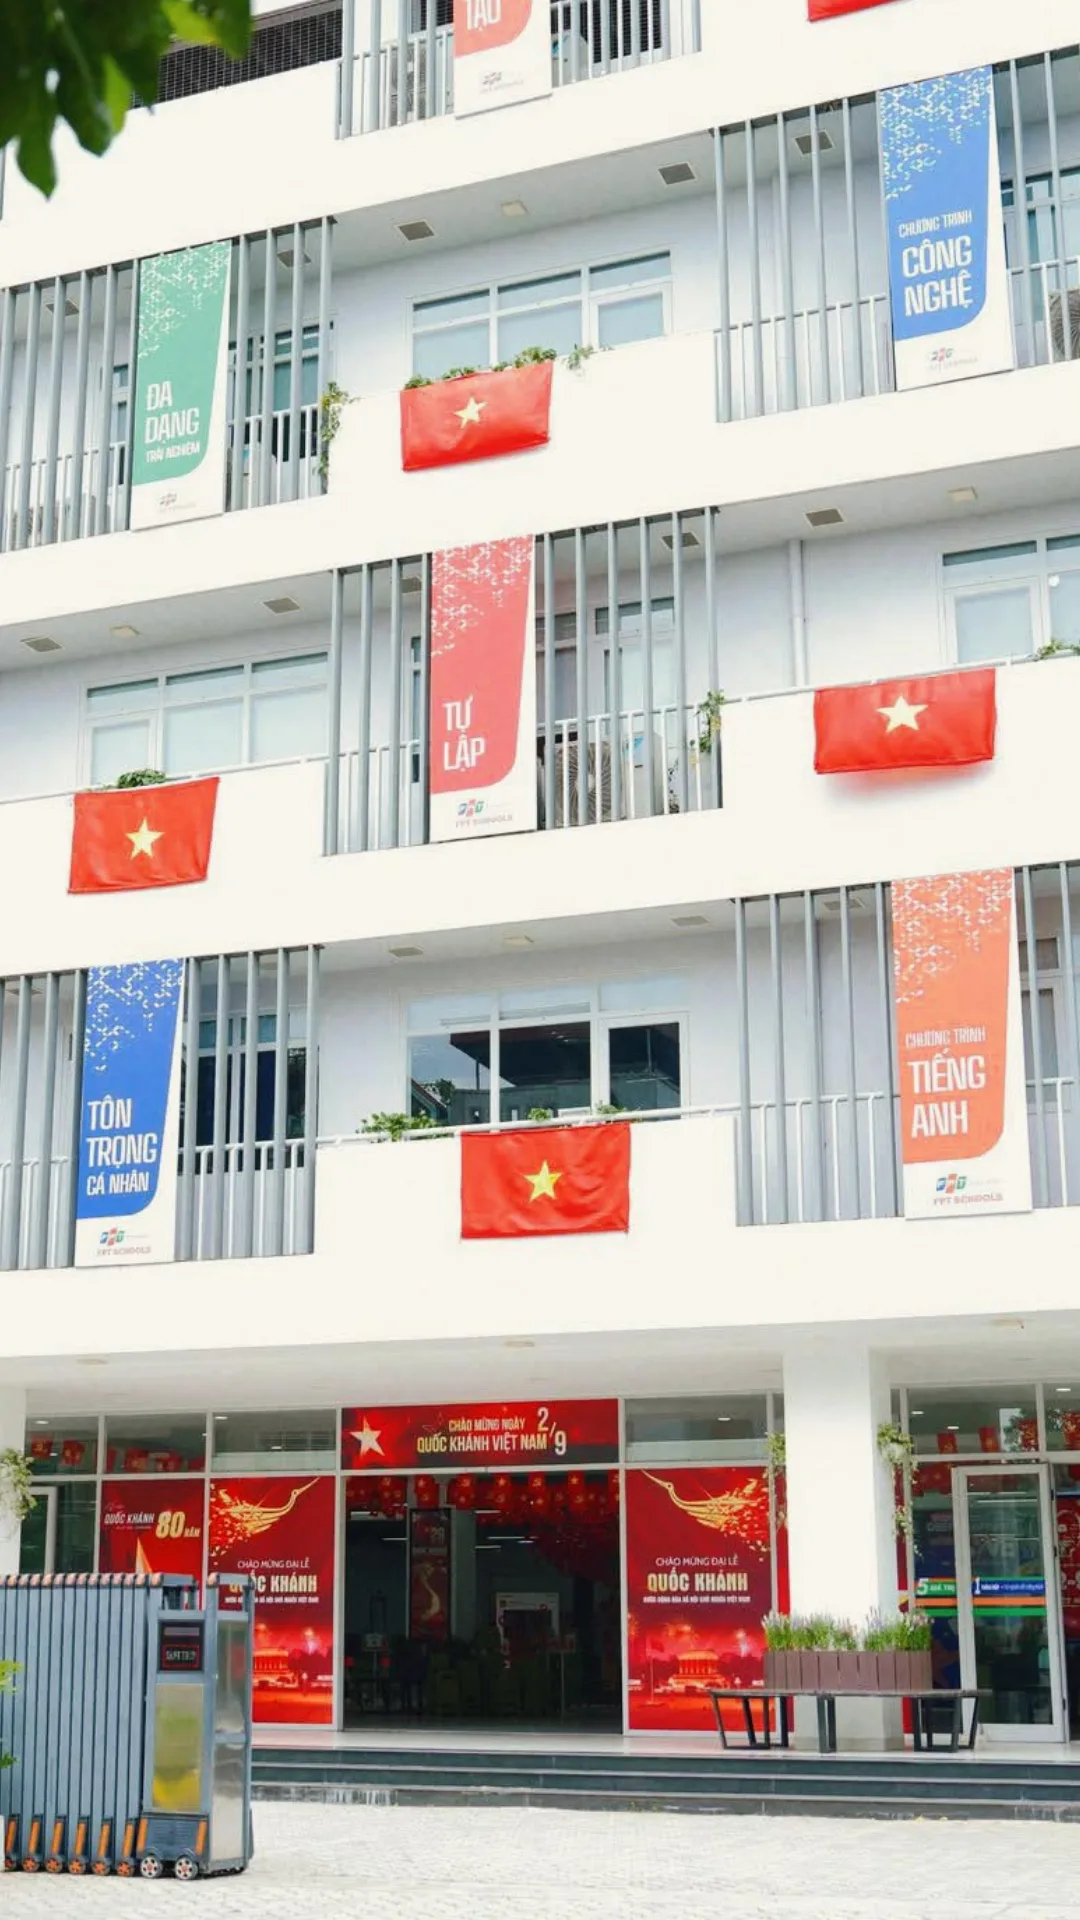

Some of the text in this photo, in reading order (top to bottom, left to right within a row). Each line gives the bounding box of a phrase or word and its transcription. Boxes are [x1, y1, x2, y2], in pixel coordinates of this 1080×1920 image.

[902, 235, 972, 278] CÔNG
[904, 269, 973, 317] NGHỆ
[146, 381, 173, 411] ĐA
[145, 407, 199, 444] DẠNG
[443, 692, 474, 734] TỰ
[444, 733, 486, 772] LẬP
[907, 1048, 986, 1094] TIẾNG
[87, 1094, 132, 1131] TÔN
[911, 1100, 968, 1138] ANH
[86, 1132, 158, 1169] TRỌNG
[86, 1169, 149, 1196] CÁ NHÂN
[449, 1416, 472, 1432] CHÀO
[474, 1416, 500, 1431] MỪNG
[501, 1416, 526, 1431] NGÀY
[417, 1432, 547, 1454] QUỐC KHÁNH VIỆT NAM
[126, 1511, 155, 1524] KHÁNH
[155, 1511, 186, 1538] 80
[237, 1558, 259, 1568] CHÀO
[260, 1558, 284, 1568] MỪNG
[655, 1556, 680, 1566] CHÀO
[682, 1555, 710, 1566] MỪNG
[270, 1571, 317, 1593] KHÁNH
[647, 1566, 748, 1592] QUỐC KHÁNH
